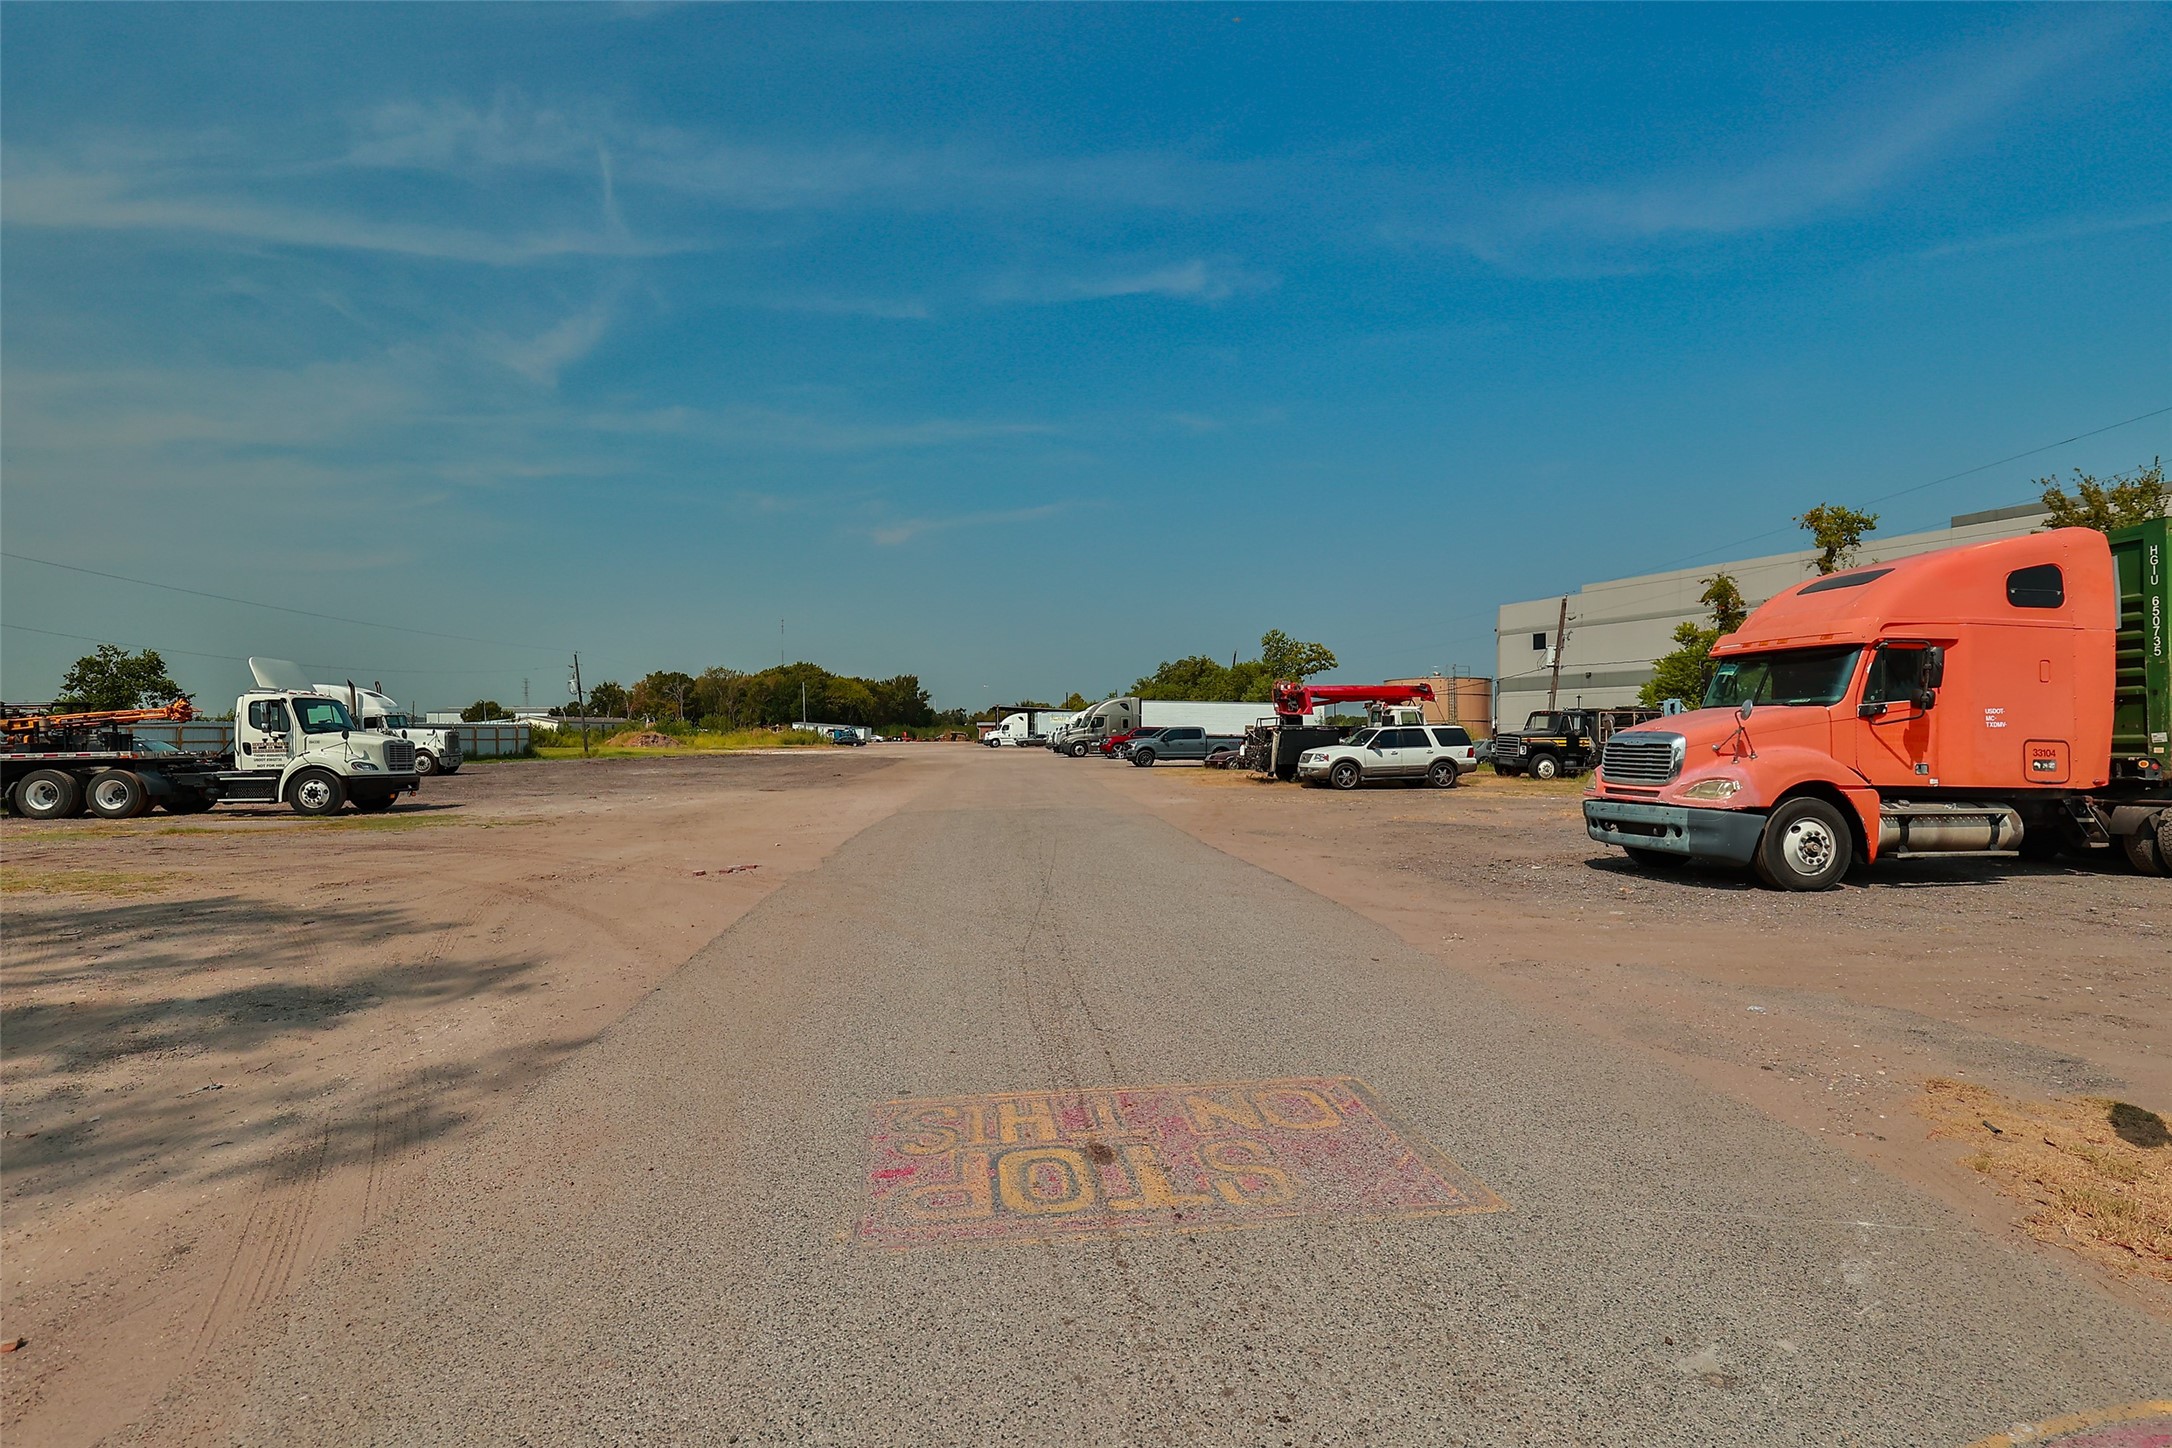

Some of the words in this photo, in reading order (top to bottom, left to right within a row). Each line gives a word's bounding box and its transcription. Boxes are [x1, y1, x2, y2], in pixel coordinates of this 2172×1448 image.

[2150, 545, 2159, 585] HGIU
[2152, 595, 2161, 657] 650735
[2032, 748, 2056, 758] 33104
[1180, 1087, 1342, 1136] ON
[901, 1138, 1298, 1220] STOP
